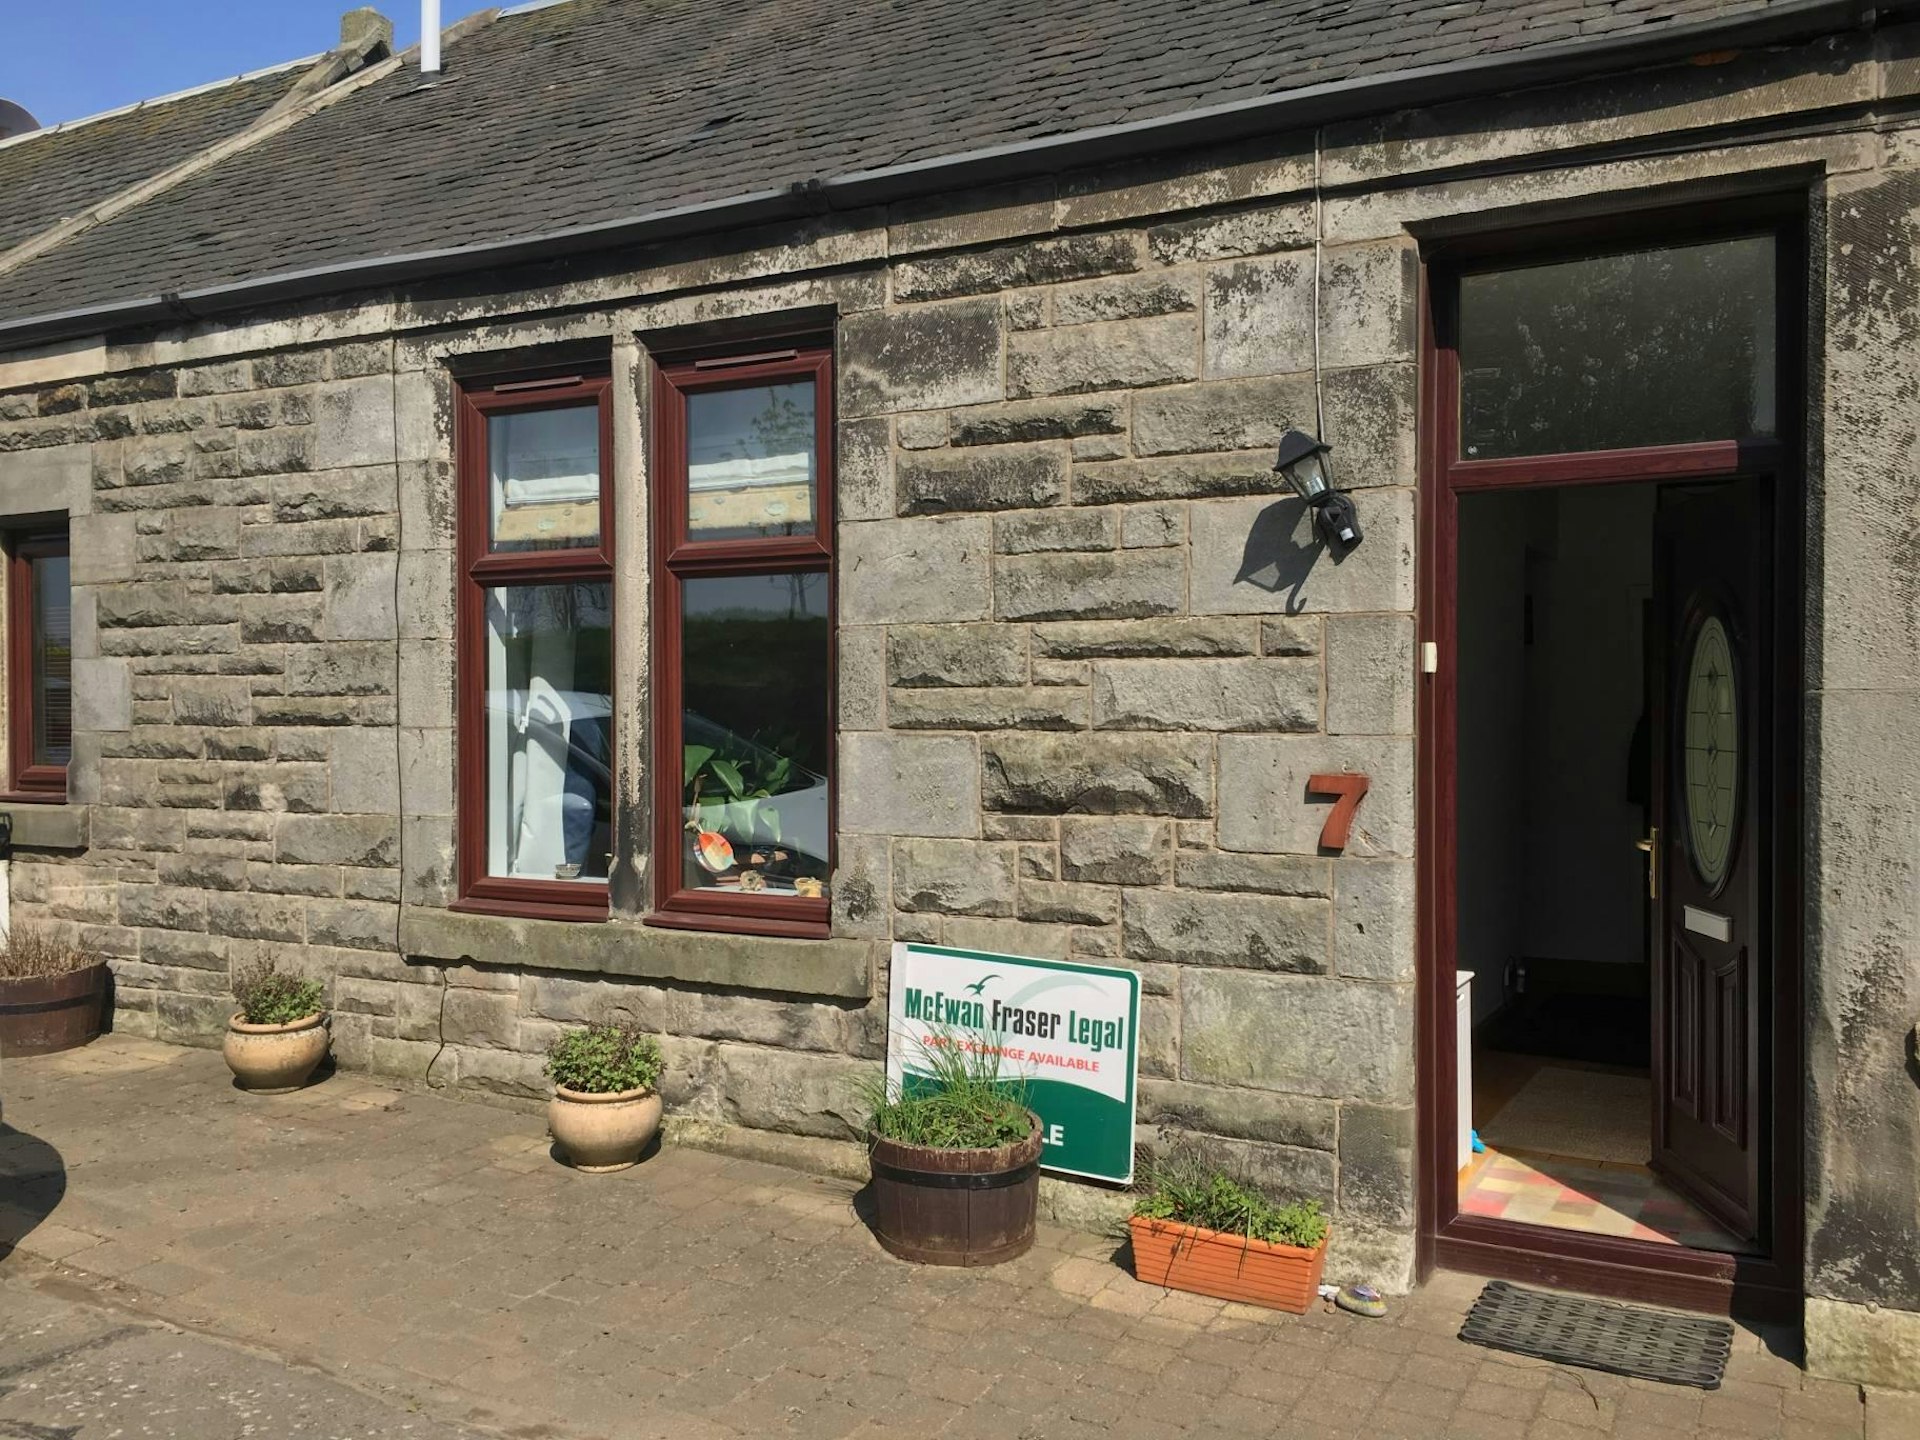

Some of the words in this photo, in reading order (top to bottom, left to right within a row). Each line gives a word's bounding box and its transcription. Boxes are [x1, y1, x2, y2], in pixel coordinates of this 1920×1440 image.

[1306, 774, 1370, 852] 7
[905, 987, 984, 1029] McEwan
[992, 999, 1061, 1040] Fraser
[1068, 1010, 1124, 1052] Legal
[923, 1035, 952, 1047] PAR
[1028, 1051, 1100, 1073] AVAILABLE
